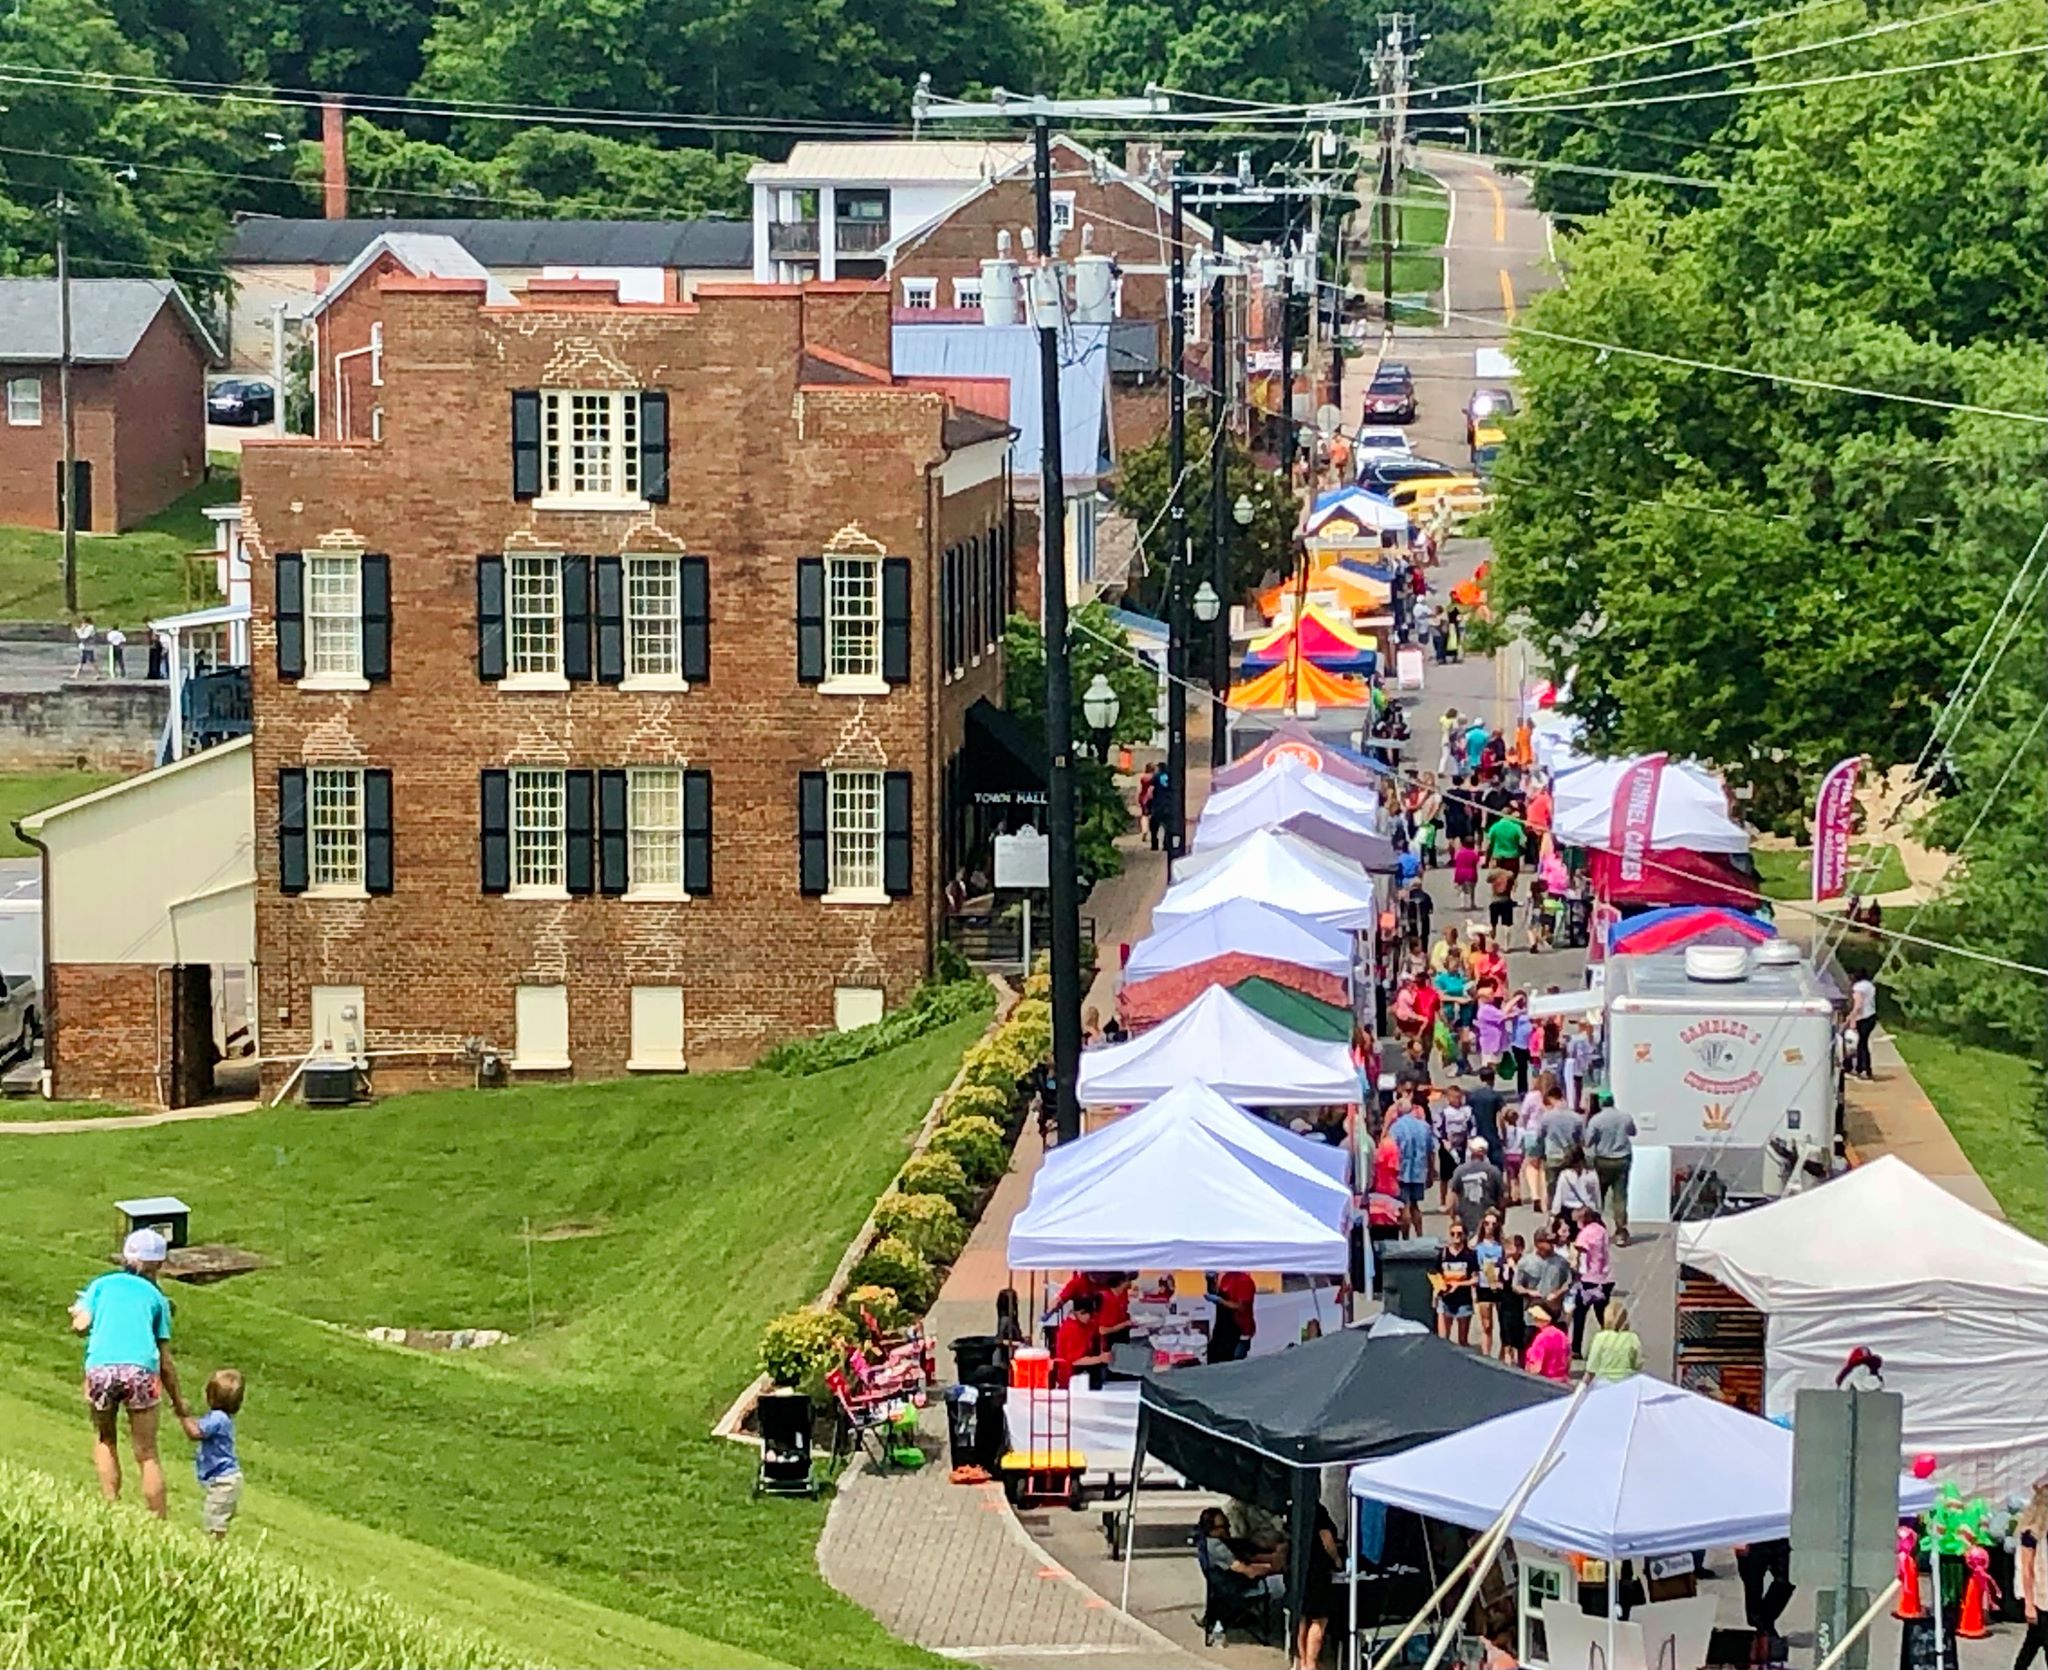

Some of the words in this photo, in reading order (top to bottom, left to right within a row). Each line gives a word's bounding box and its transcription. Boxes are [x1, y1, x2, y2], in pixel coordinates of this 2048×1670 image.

[974, 792, 1012, 804] TOWN
[1015, 792, 1048, 805] HALL
[1626, 767, 1653, 827] FUNNEL
